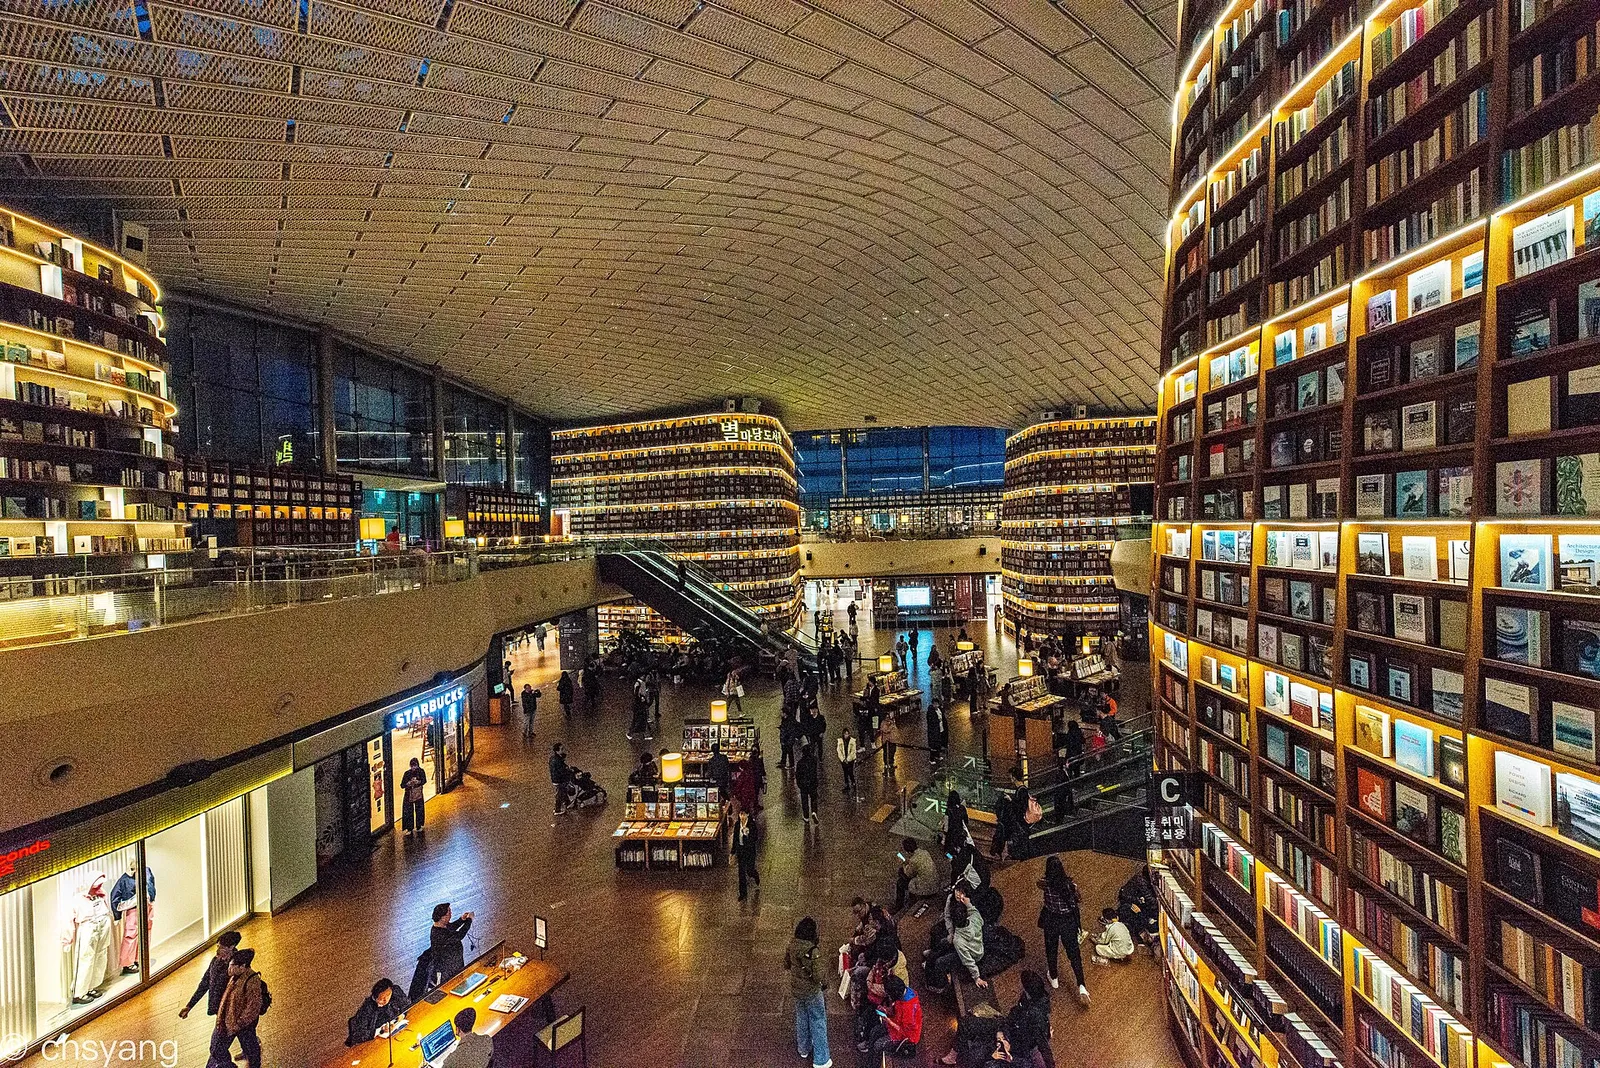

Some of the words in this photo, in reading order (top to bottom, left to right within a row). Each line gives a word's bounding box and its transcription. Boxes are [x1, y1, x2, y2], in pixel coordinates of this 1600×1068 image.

[395, 687, 464, 728] STARBUCKS
[1161, 777, 1180, 802] C
[1161, 816, 1184, 827] 취미
[1162, 828, 1186, 840] 실용
